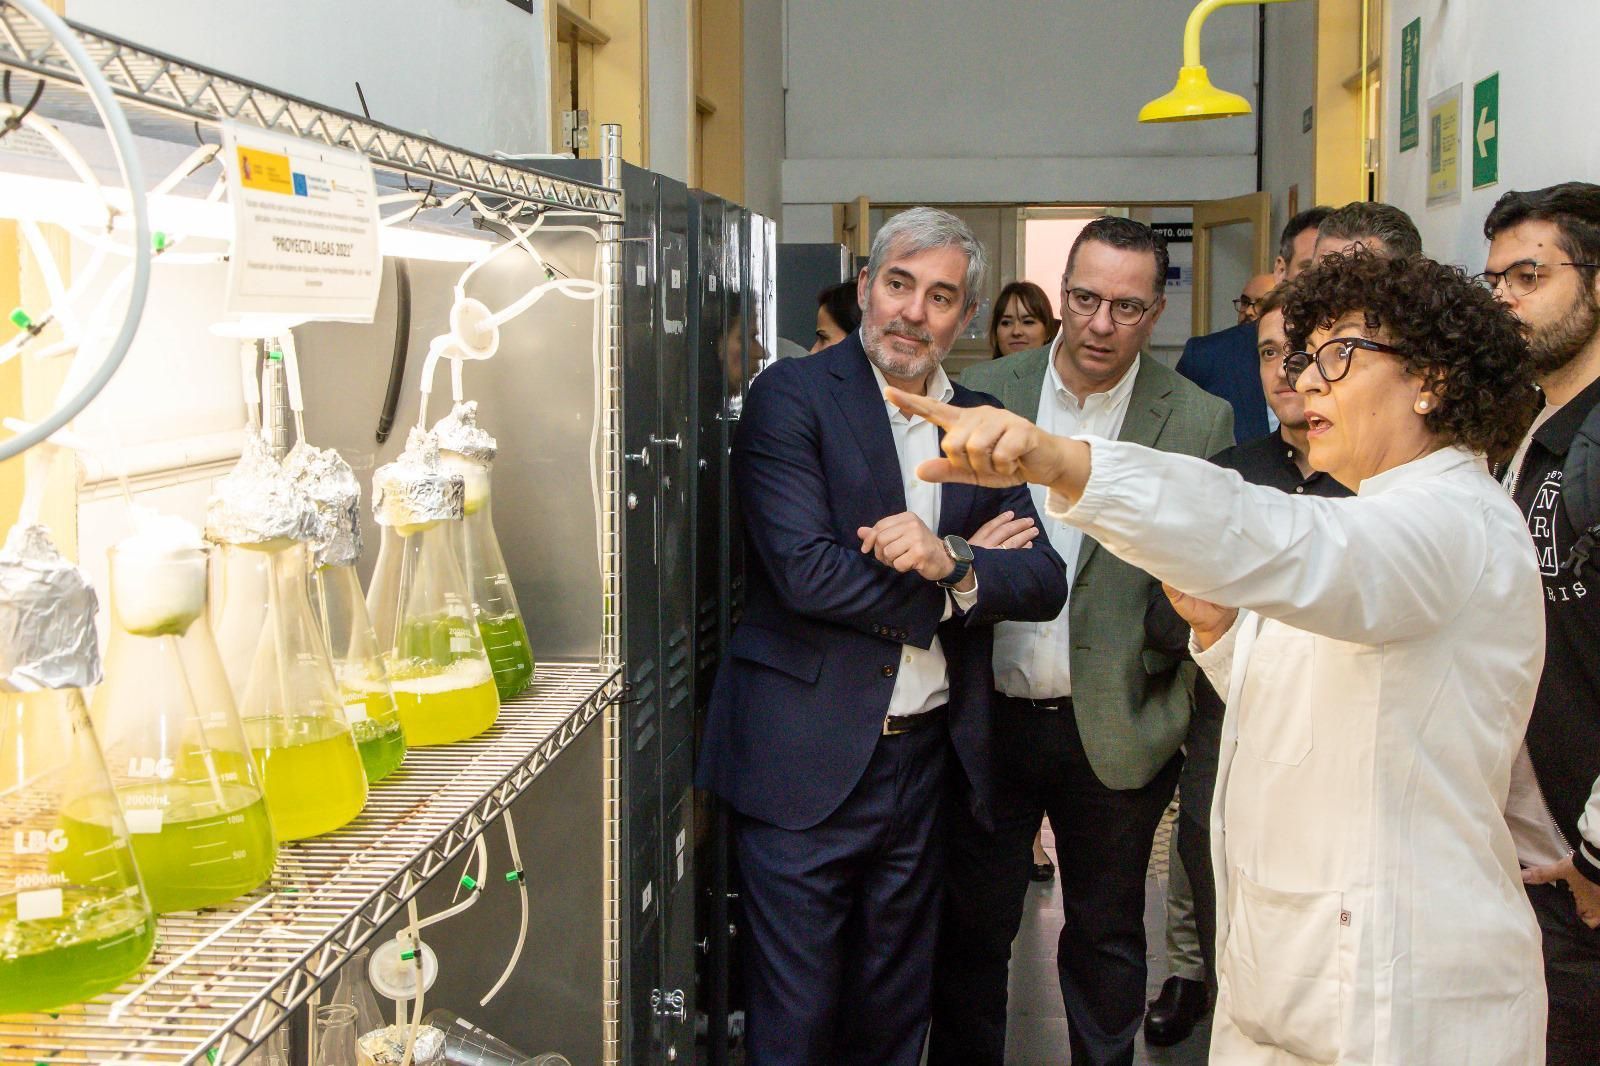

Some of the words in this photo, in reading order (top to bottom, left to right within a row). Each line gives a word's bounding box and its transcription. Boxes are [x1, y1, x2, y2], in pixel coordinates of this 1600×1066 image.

[314, 240, 335, 256] ALGAS
[127, 757, 175, 779] LBG
[14, 829, 69, 854] LBG
